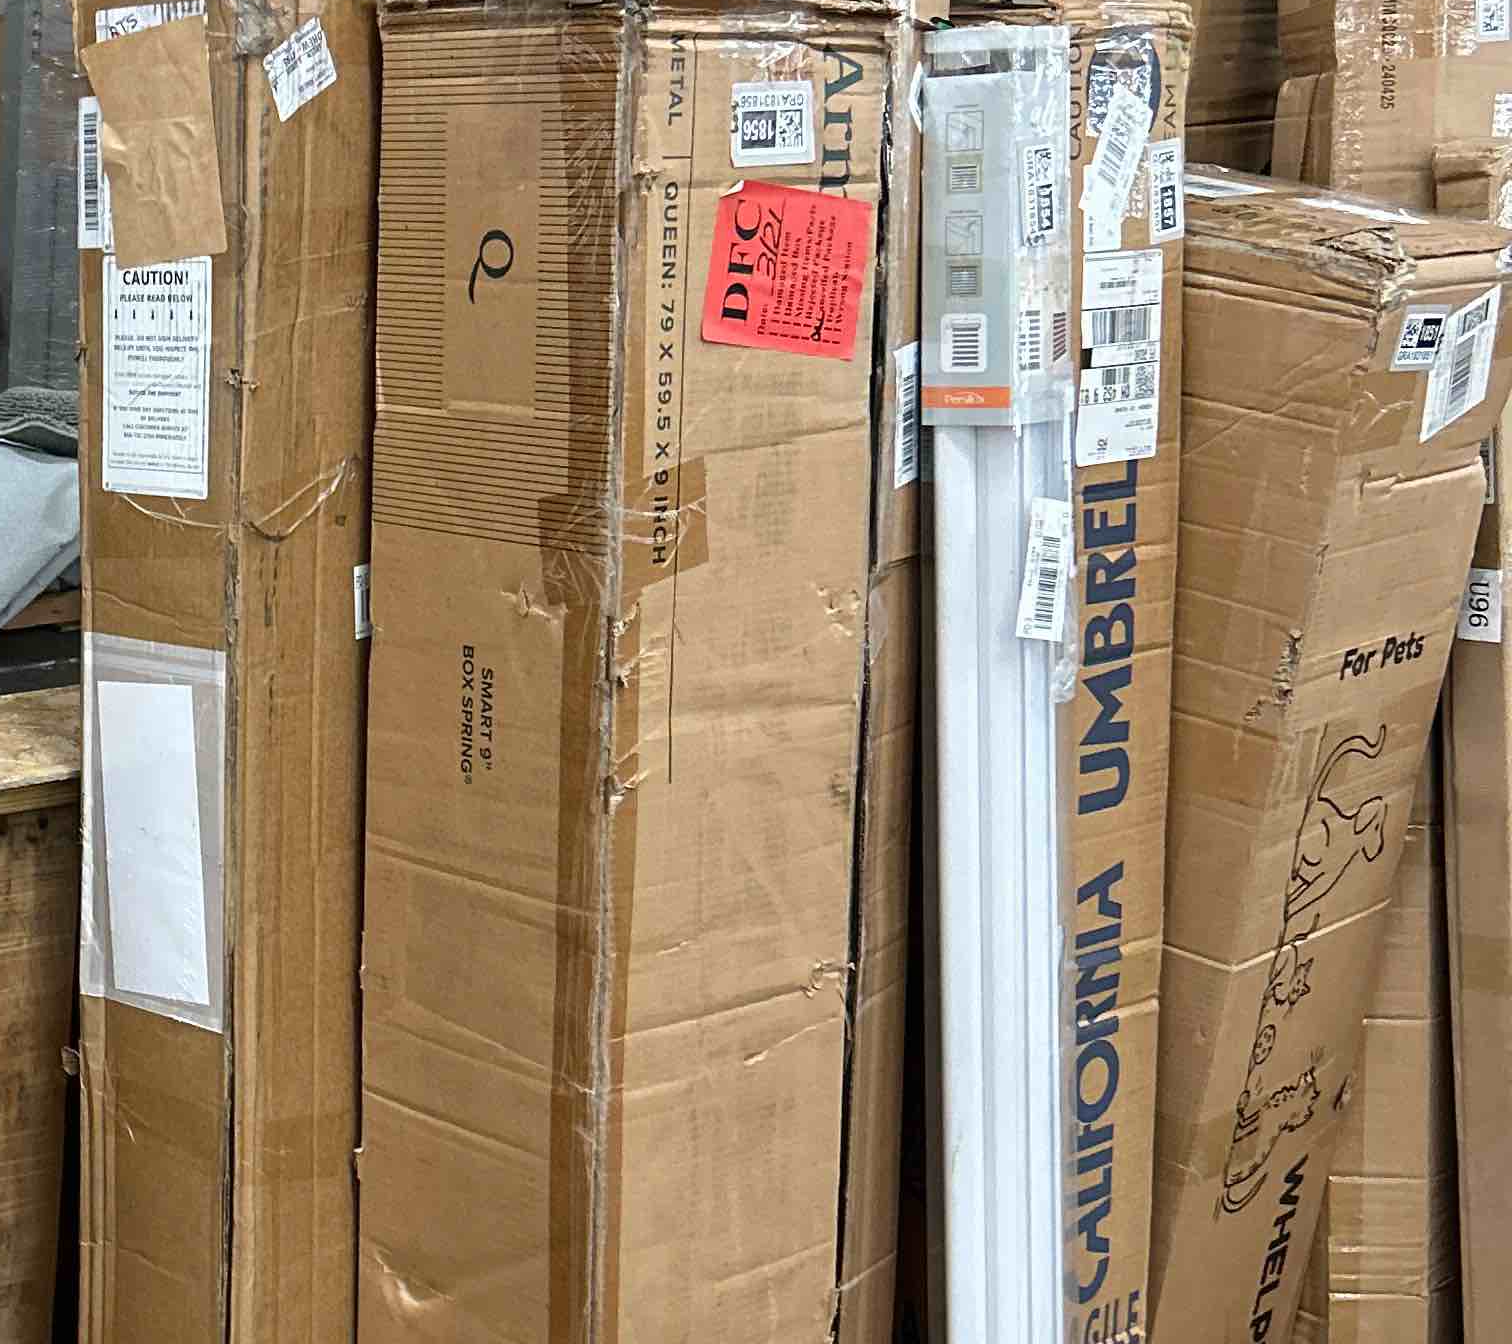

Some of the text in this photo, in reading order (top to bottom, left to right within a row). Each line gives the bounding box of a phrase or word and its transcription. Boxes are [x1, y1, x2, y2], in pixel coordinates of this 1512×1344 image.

[742, 118, 775, 141] 1856
[1162, 187, 1176, 229] 1857
[123, 270, 189, 286] CAUTION!
[721, 199, 762, 321] DFC
[119, 294, 145, 303] PLEASE
[146, 294, 166, 303] READ
[652, 33, 686, 565] METAL QUEEN: 79 X 59.5 X 9 INCH
[1078, 458, 1139, 816] UMBREL
[1340, 632, 1425, 681] For Pets
[461, 644, 475, 690] BOX
[481, 667, 494, 743] SMART
